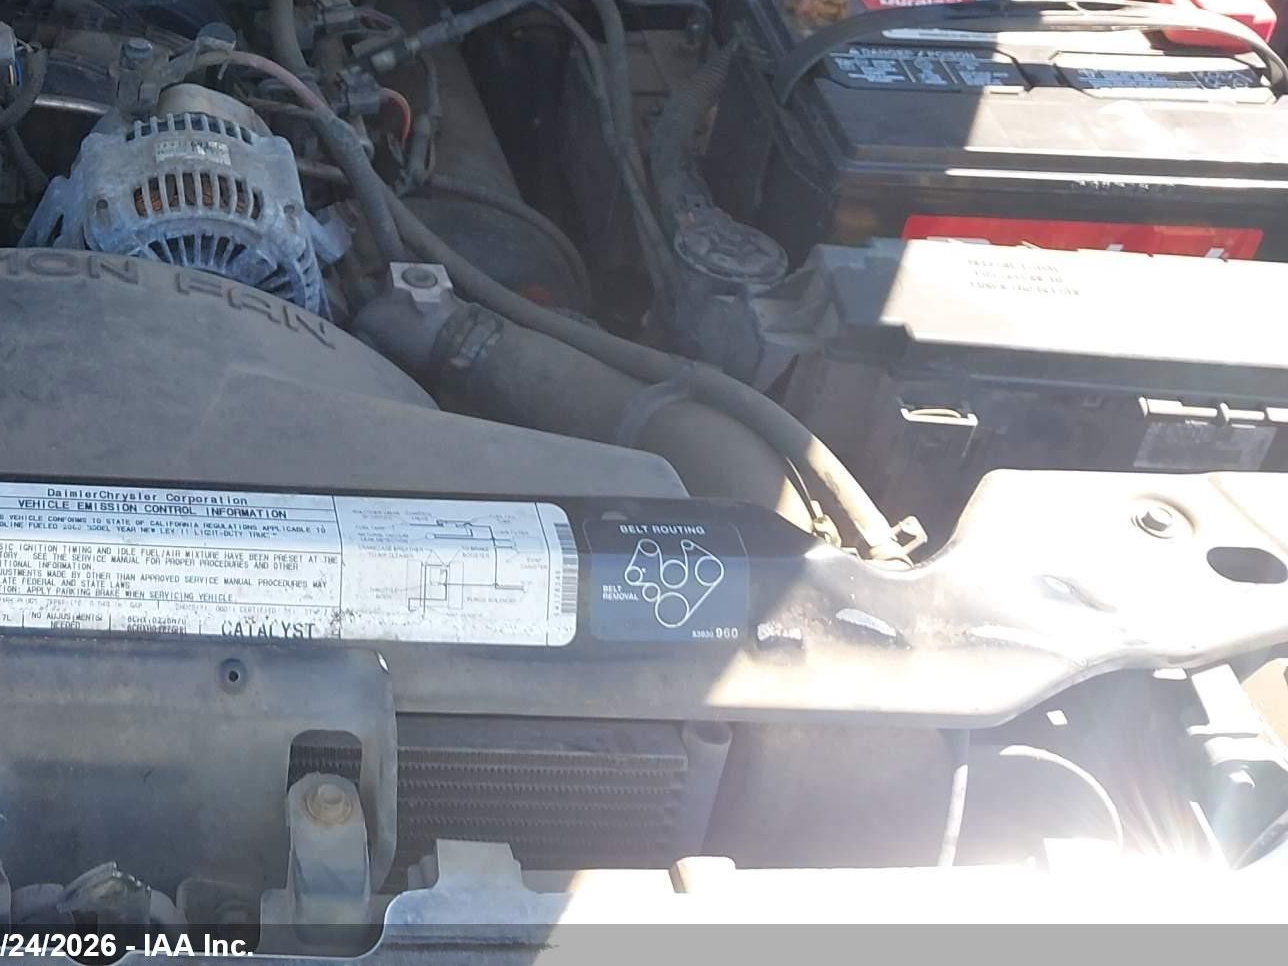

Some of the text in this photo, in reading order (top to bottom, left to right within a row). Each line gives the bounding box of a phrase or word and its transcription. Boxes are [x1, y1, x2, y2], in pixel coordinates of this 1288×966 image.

[173, 268, 336, 350] FAN
[48, 488, 248, 507] DaimlerChrysler Corporation
[18, 500, 287, 520] VEHICLE EMISSION CONTROL INFORMATION
[150, 520, 200, 529] CALIFORNIA
[619, 524, 706, 535] BELT ROUTING
[18, 544, 58, 553] IGNITION
[62, 546, 92, 554] TIMING
[116, 548, 136, 556] IDLE
[141, 549, 181, 558] FUEL/AIR
[185, 551, 220, 559] MIXTURE
[224, 552, 244, 560] HAVE
[249, 553, 269, 561] BEEN
[273, 554, 303, 562] PRESET
[72, 554, 107, 563] SERVICE
[111, 556, 141, 565] MANUAL
[165, 558, 195, 567] PROPER
[274, 562, 299, 570] OTHER
[22, 578, 57, 586] FEDERAL
[81, 580, 106, 588] STATE
[47, 571, 67, 579] MADE
[87, 572, 112, 580] OTHER
[116, 573, 136, 581] THAN
[185, 576, 220, 584] SERVICE
[224, 577, 254, 585] MANUAL
[26, 587, 51, 595] APPLY
[56, 588, 90, 596] PARKING
[95, 589, 120, 597] BRAKE
[124, 590, 145, 598] WHEN
[149, 591, 194, 600] SERVICING
[602, 585, 622, 593] BELT
[602, 592, 639, 601] REMOVAL
[221, 619, 315, 639] CATALYST
